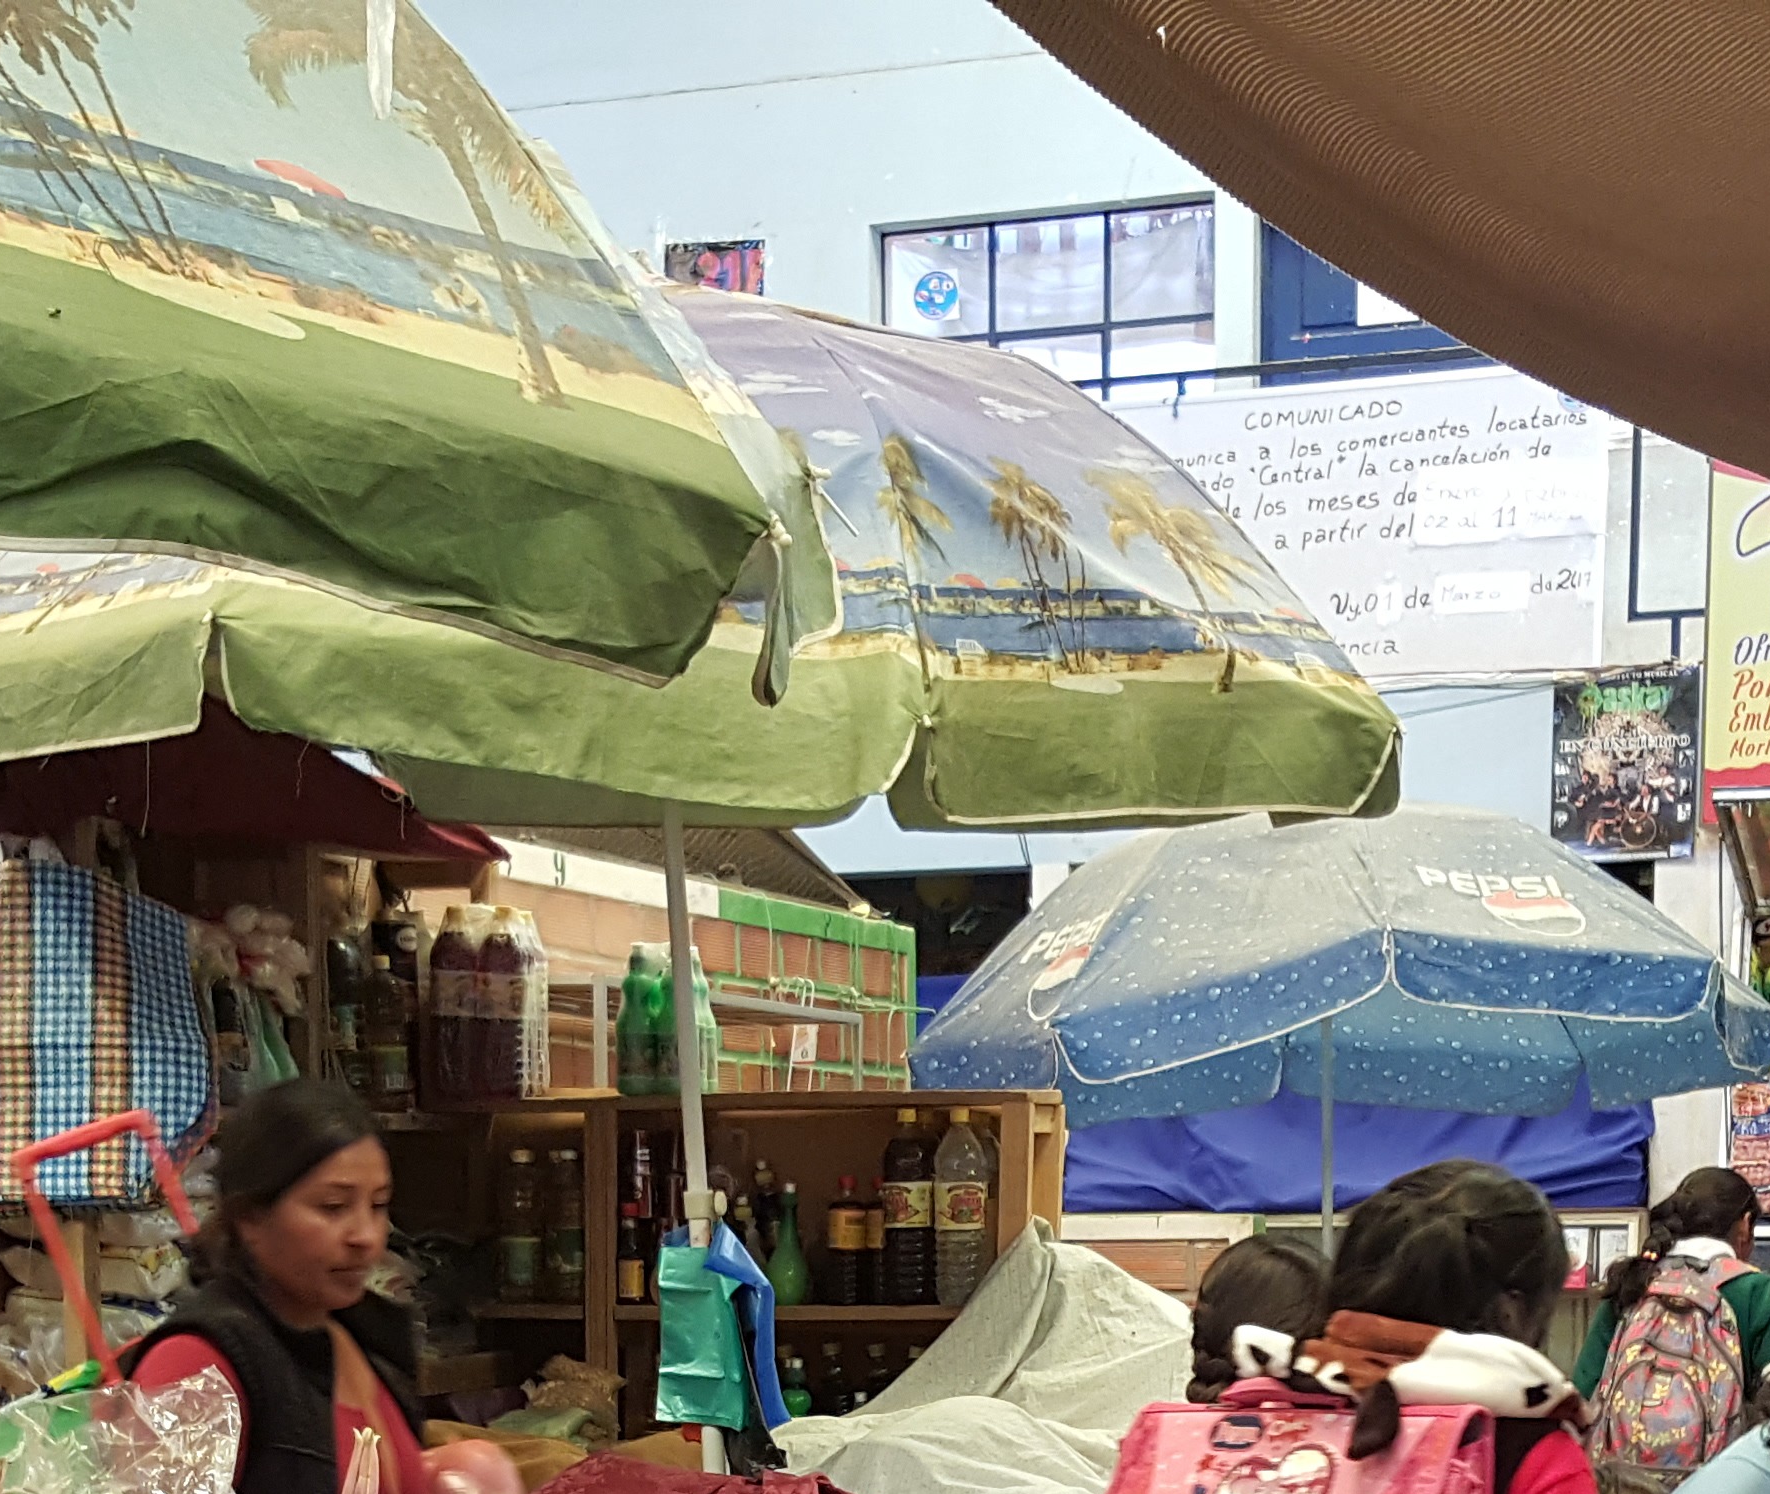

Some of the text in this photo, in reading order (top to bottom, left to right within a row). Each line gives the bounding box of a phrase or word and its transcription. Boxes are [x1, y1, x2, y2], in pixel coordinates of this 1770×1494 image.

[1245, 400, 1403, 431] COMUNICADO
[1290, 437, 1323, 460] los
[1487, 405, 1588, 433] locatarios
[1389, 443, 1510, 473] cancelación
[1528, 437, 1552, 459] de
[1254, 493, 1287, 520] los
[1308, 491, 1380, 512] meses
[1393, 481, 1418, 507] de
[1274, 534, 1289, 550] a
[1302, 518, 1368, 551] partir
[1379, 513, 1414, 540] del
[1404, 585, 1431, 609] de
[553, 855, 567, 887] 9
[1415, 865, 1563, 899] PEPSI
